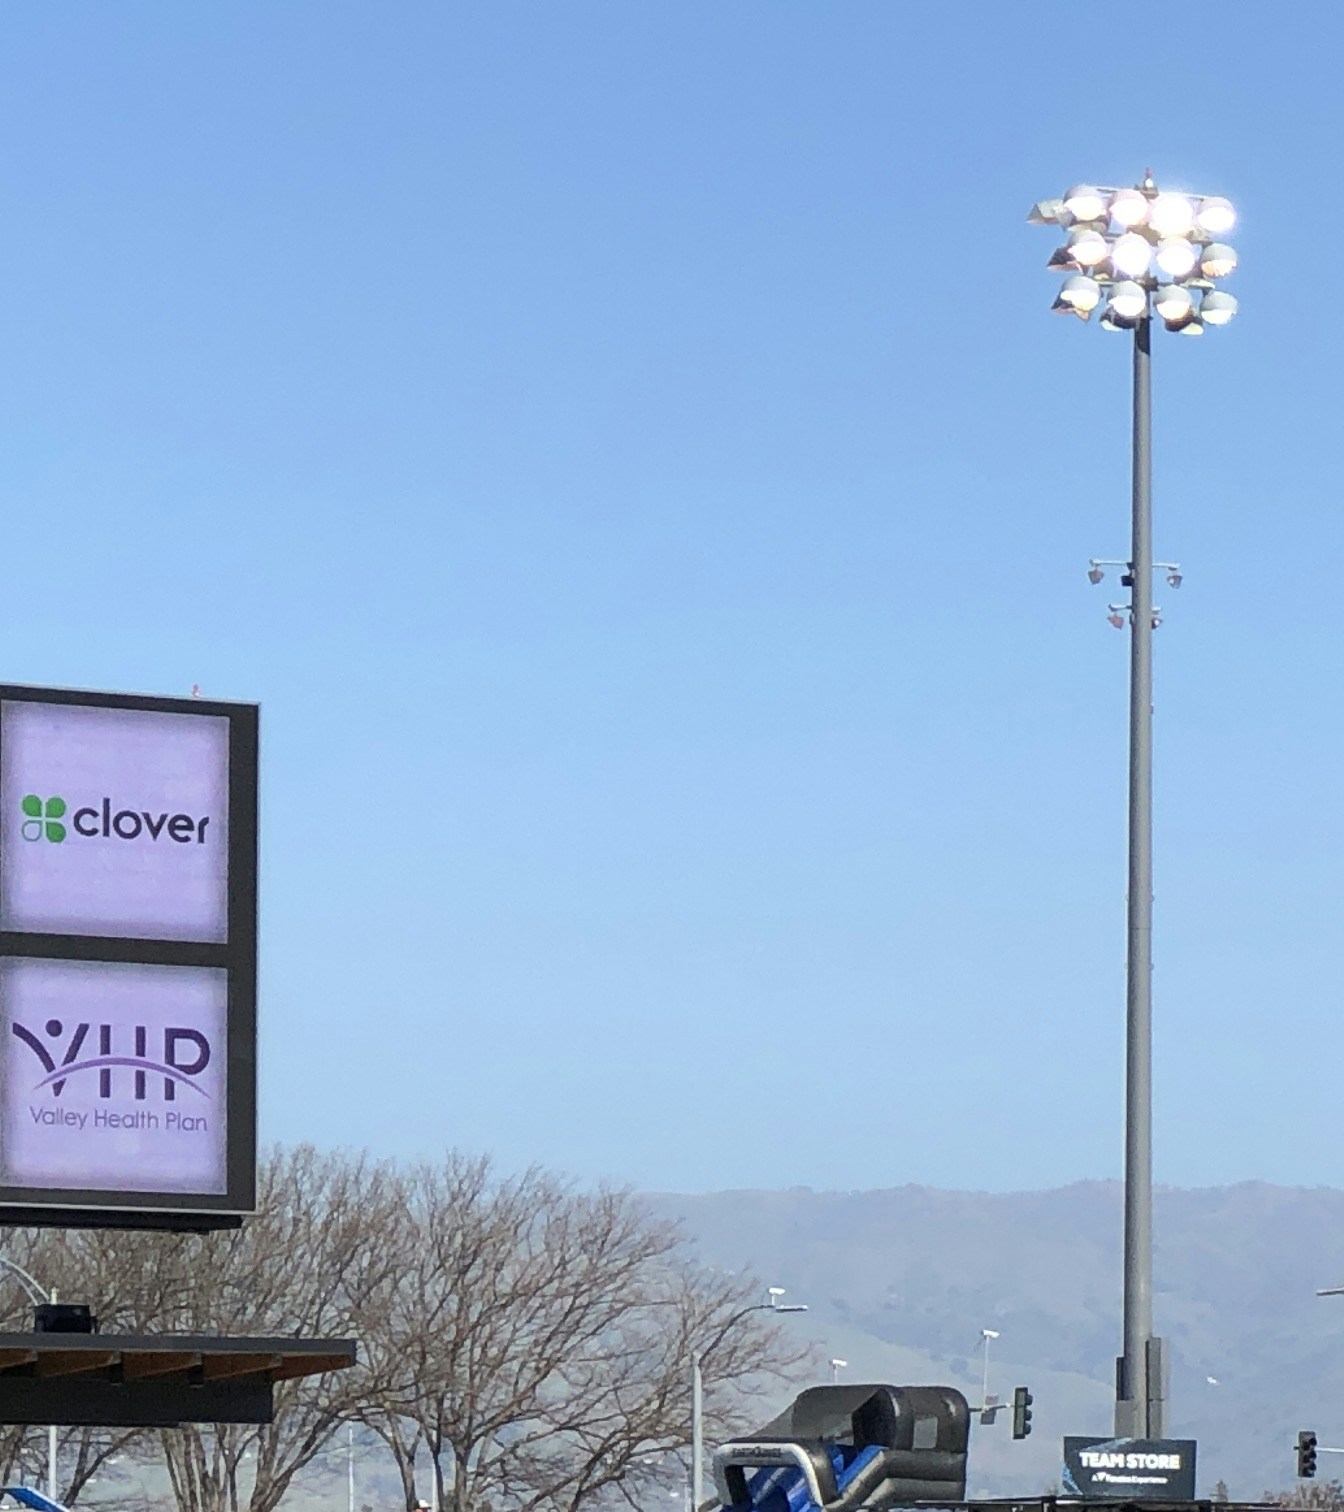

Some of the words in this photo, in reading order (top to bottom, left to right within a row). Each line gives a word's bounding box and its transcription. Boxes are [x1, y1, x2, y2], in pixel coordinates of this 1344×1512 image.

[74, 798, 209, 843] clover
[13, 1019, 211, 1101] VHP
[30, 1106, 88, 1130] Valley
[94, 1109, 159, 1129] Health
[165, 1112, 208, 1131] Plan
[1079, 1452, 1125, 1469] TEAM
[1126, 1453, 1181, 1470] STORE
